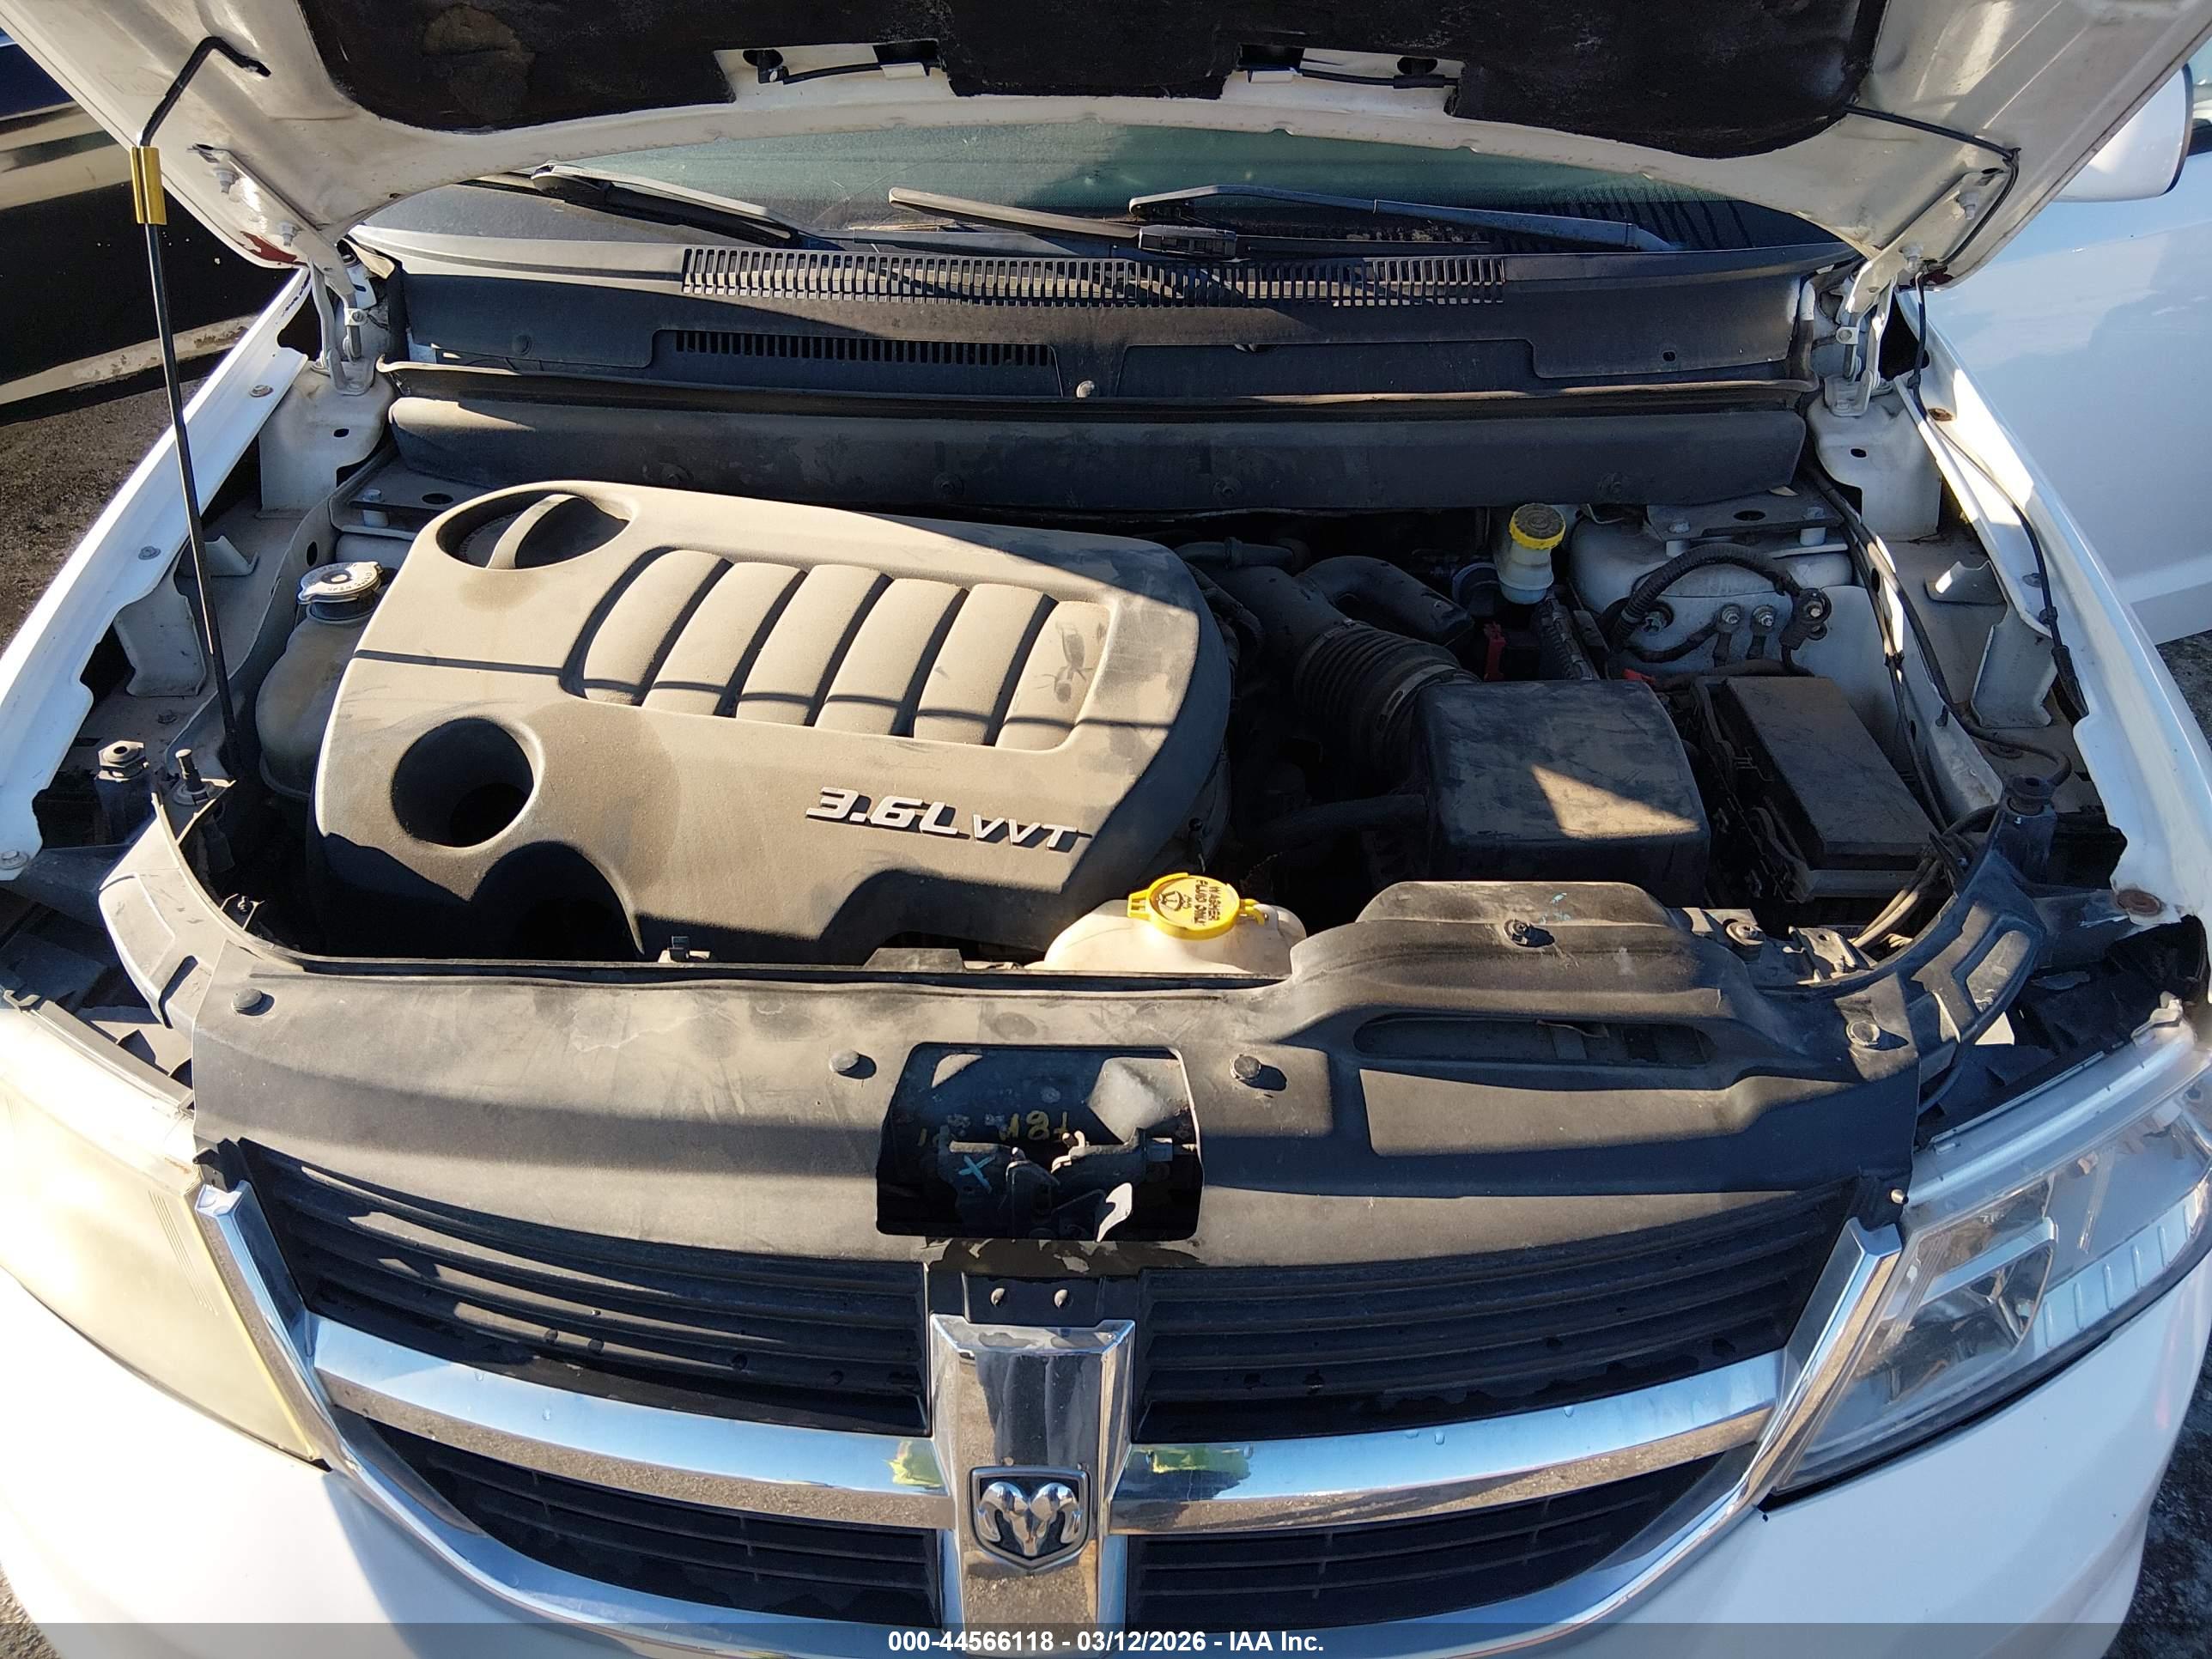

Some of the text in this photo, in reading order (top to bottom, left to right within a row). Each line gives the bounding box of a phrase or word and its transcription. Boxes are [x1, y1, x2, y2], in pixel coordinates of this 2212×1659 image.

[805, 786, 1079, 848] 3.6L VVT
[1194, 879, 1208, 902] FLUID
